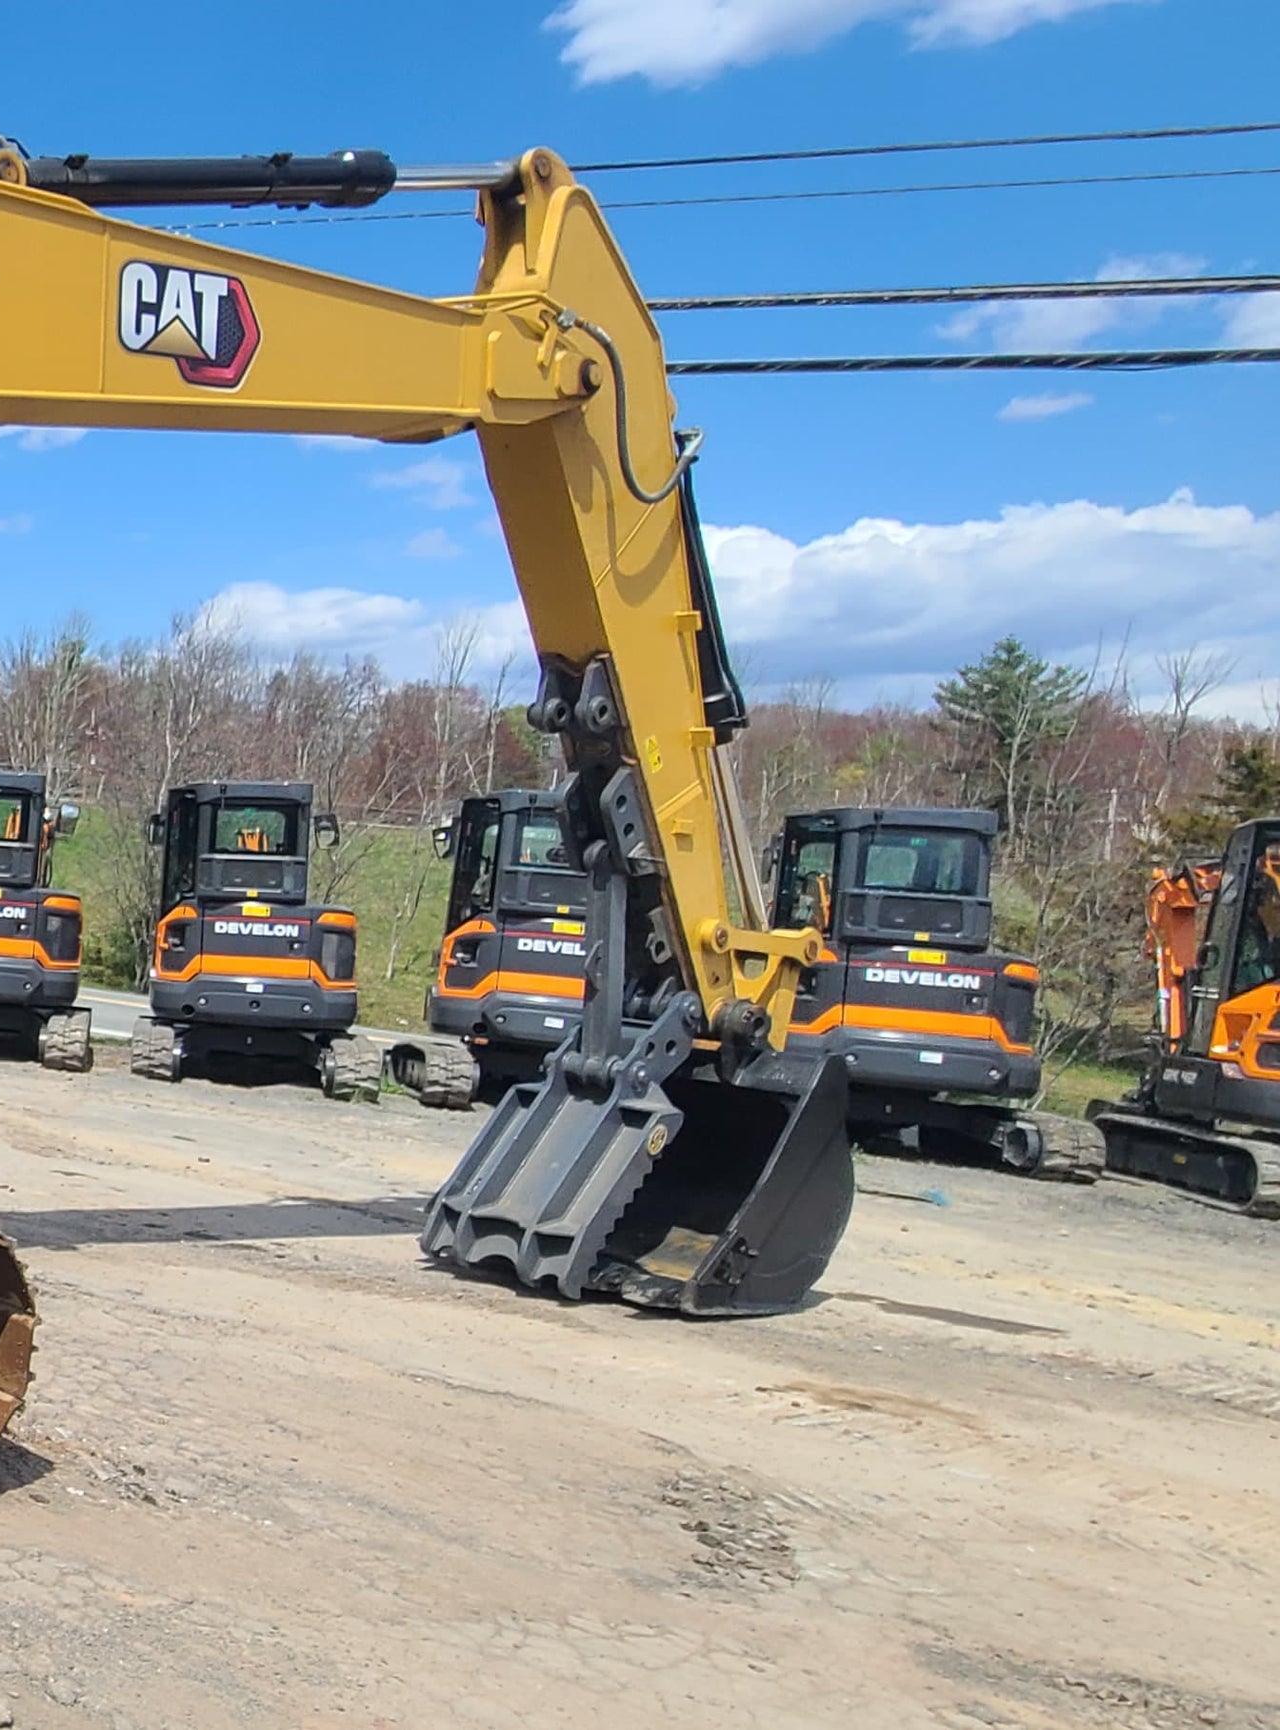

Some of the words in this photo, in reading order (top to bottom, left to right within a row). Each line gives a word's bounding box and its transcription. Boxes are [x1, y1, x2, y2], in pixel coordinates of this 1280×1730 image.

[121, 262, 228, 361] CAT
[214, 921, 299, 937] DEVELON
[517, 938, 586, 956] DEVEL
[865, 967, 981, 989] DEVELON
